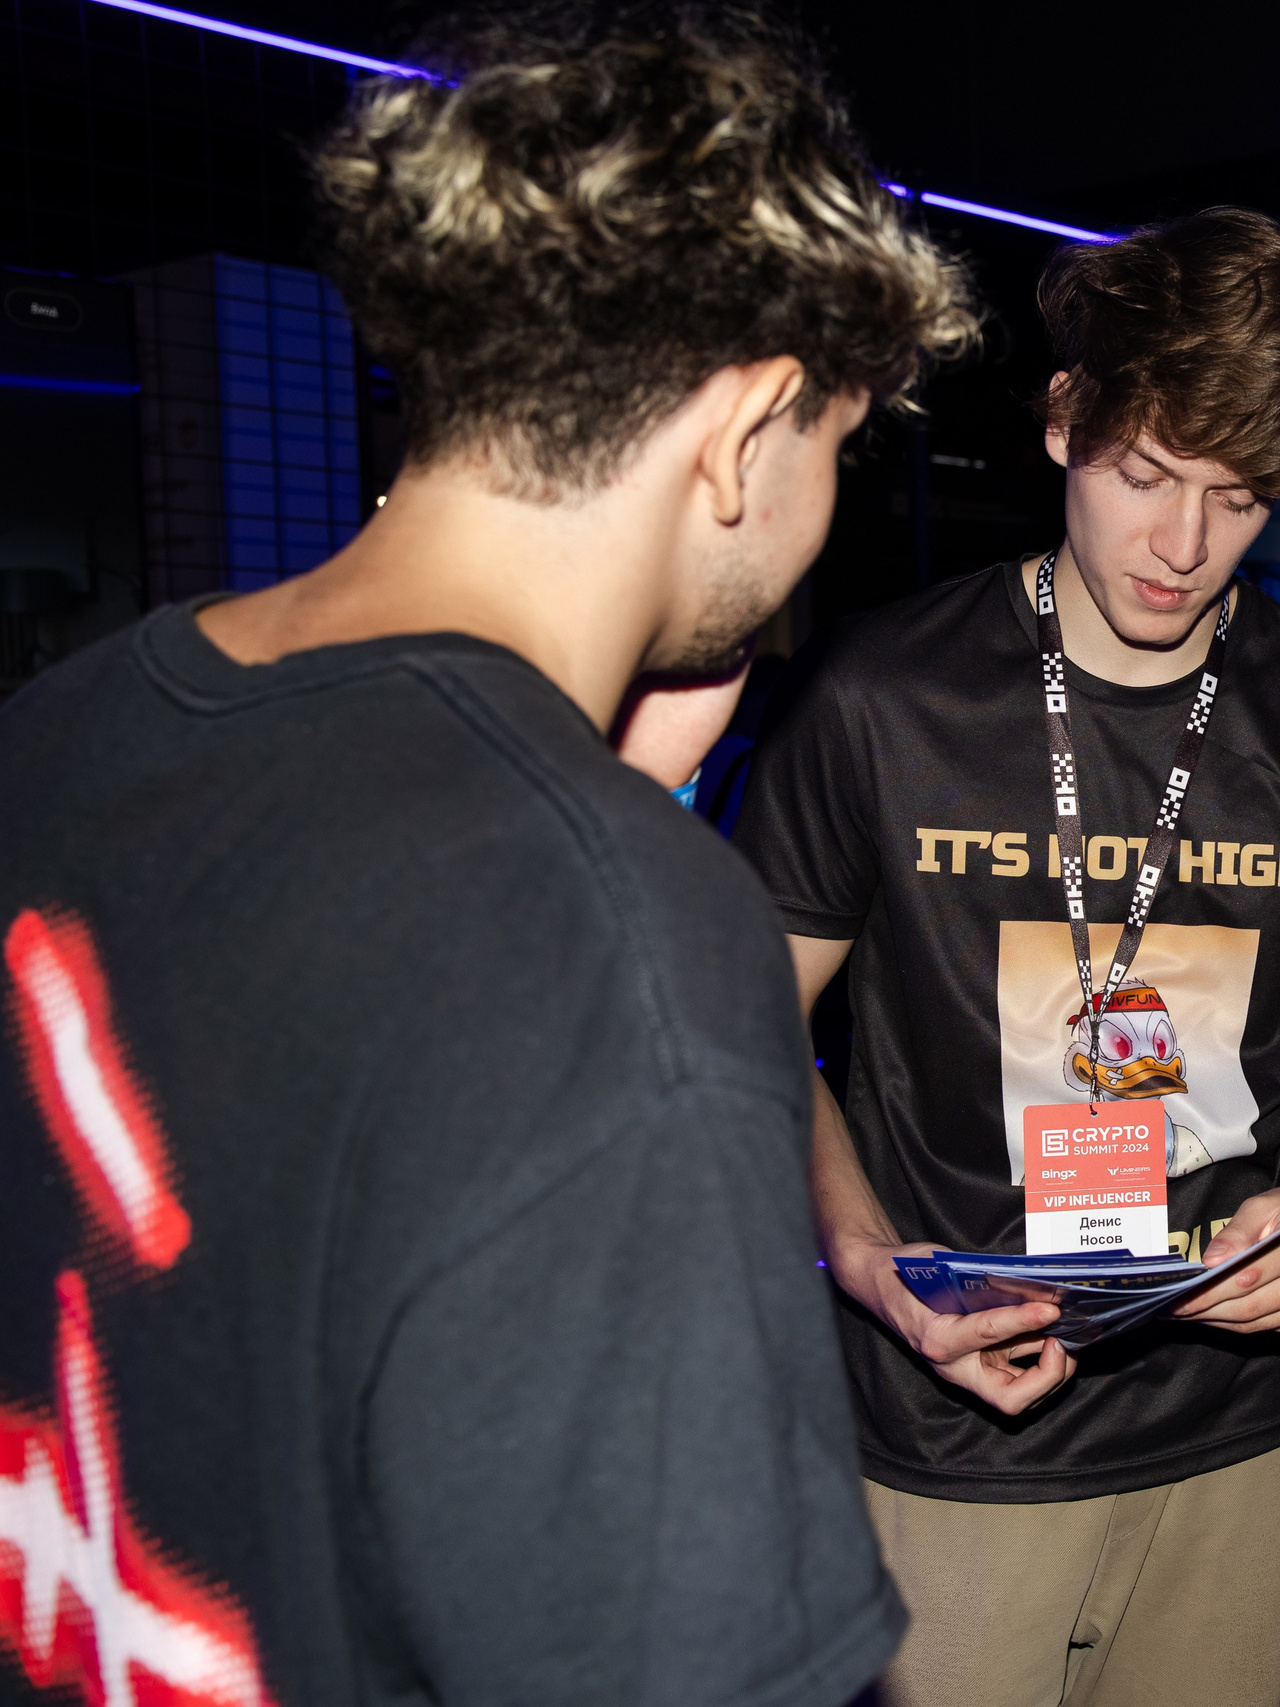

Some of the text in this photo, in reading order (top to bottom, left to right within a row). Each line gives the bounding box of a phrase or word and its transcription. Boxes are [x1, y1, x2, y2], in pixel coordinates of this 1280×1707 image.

[916, 827, 1030, 878] IT'S
[1072, 1125, 1149, 1143] CRYPTO
[1073, 1143, 1150, 1156] SUMMIT 2024
[1044, 1191, 1151, 1207] VIP INFLUENCER
[1079, 1217, 1122, 1230] Денис
[1080, 1235, 1123, 1246] Носов
